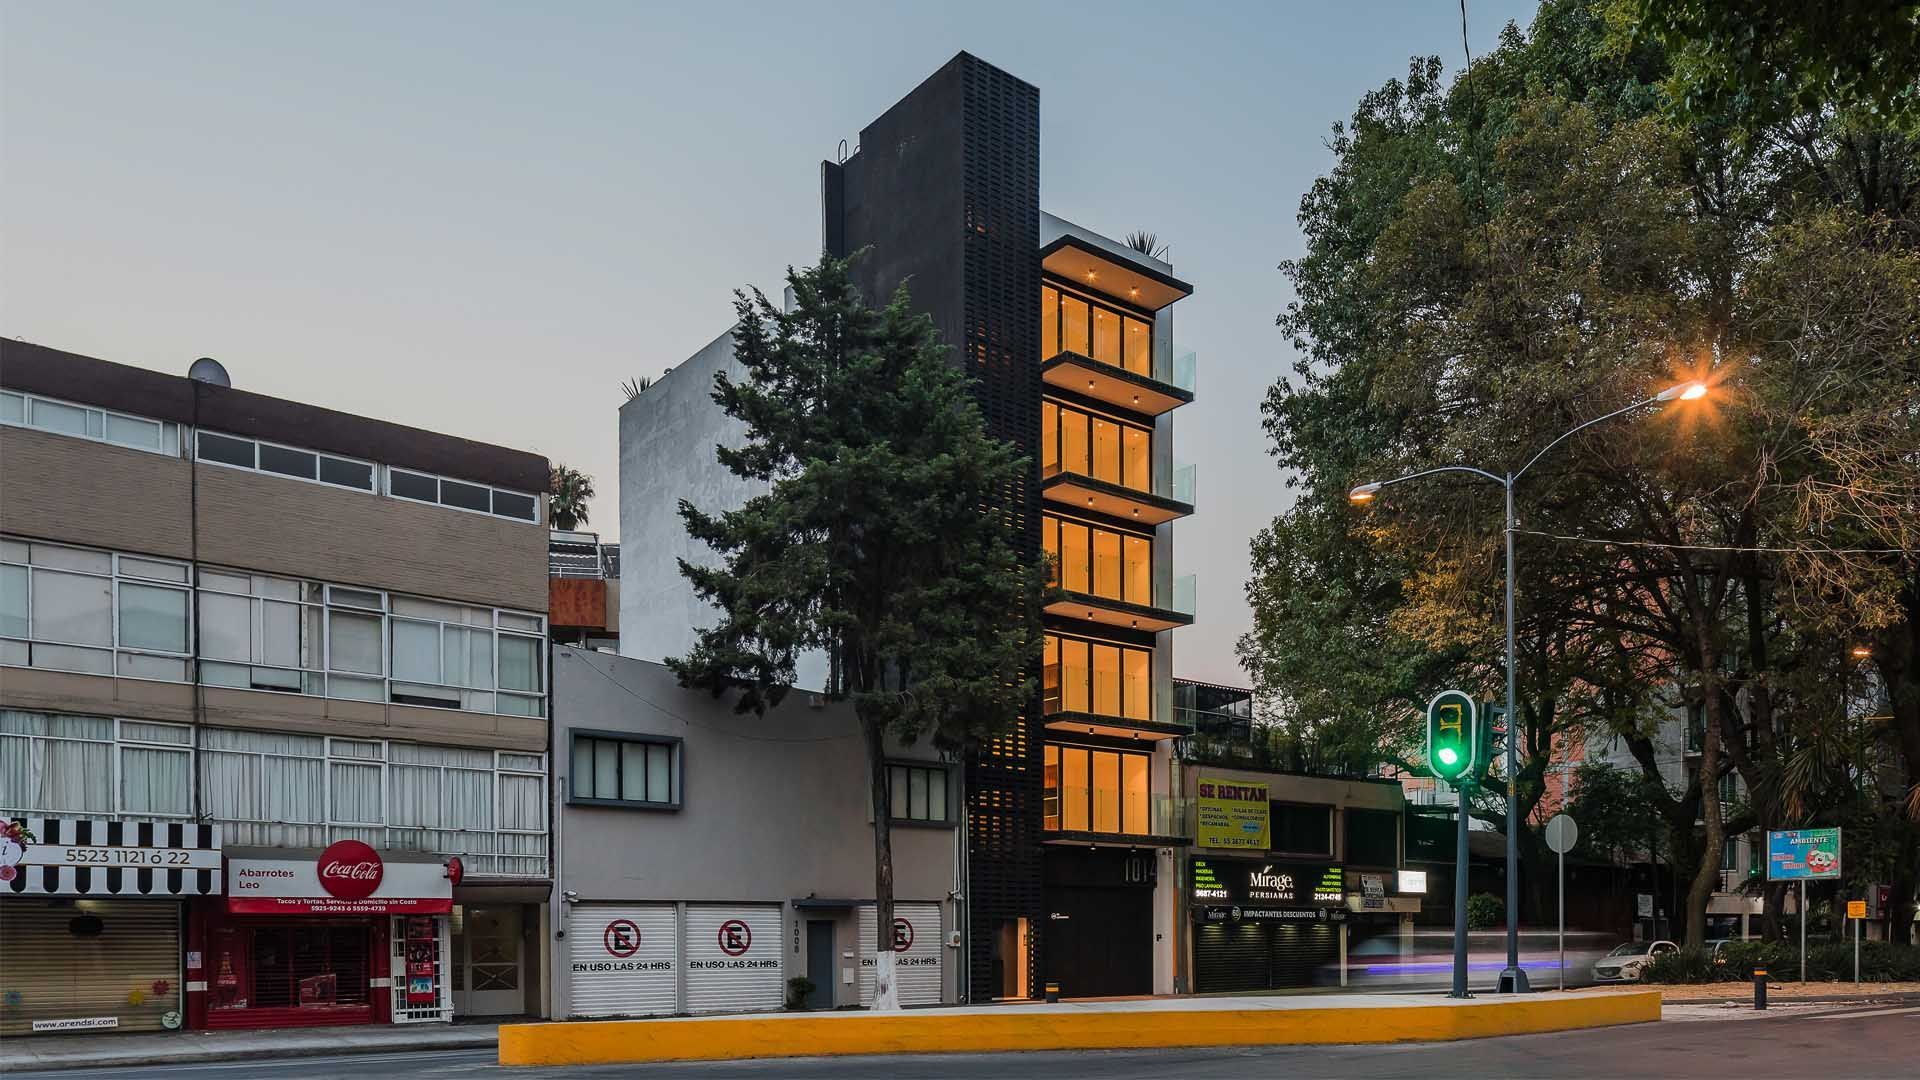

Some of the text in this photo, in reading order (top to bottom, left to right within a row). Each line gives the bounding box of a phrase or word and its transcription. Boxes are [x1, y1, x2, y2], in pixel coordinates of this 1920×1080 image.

[1200, 784, 1267, 802] SE RENTAN
[66, 850, 190, 865] 5523 1121 ó 22
[239, 868, 294, 878] Abarrotes
[322, 860, 381, 880] Coca-Cola
[239, 880, 260, 889] Leo
[1243, 910, 1282, 918] IMPACTANTES
[573, 962, 671, 971] EN USO LAS 24 HRS
[690, 961, 703, 969] EN
[705, 961, 725, 969] USO
[760, 960, 778, 968] HRS
[910, 958, 919, 966] 24
